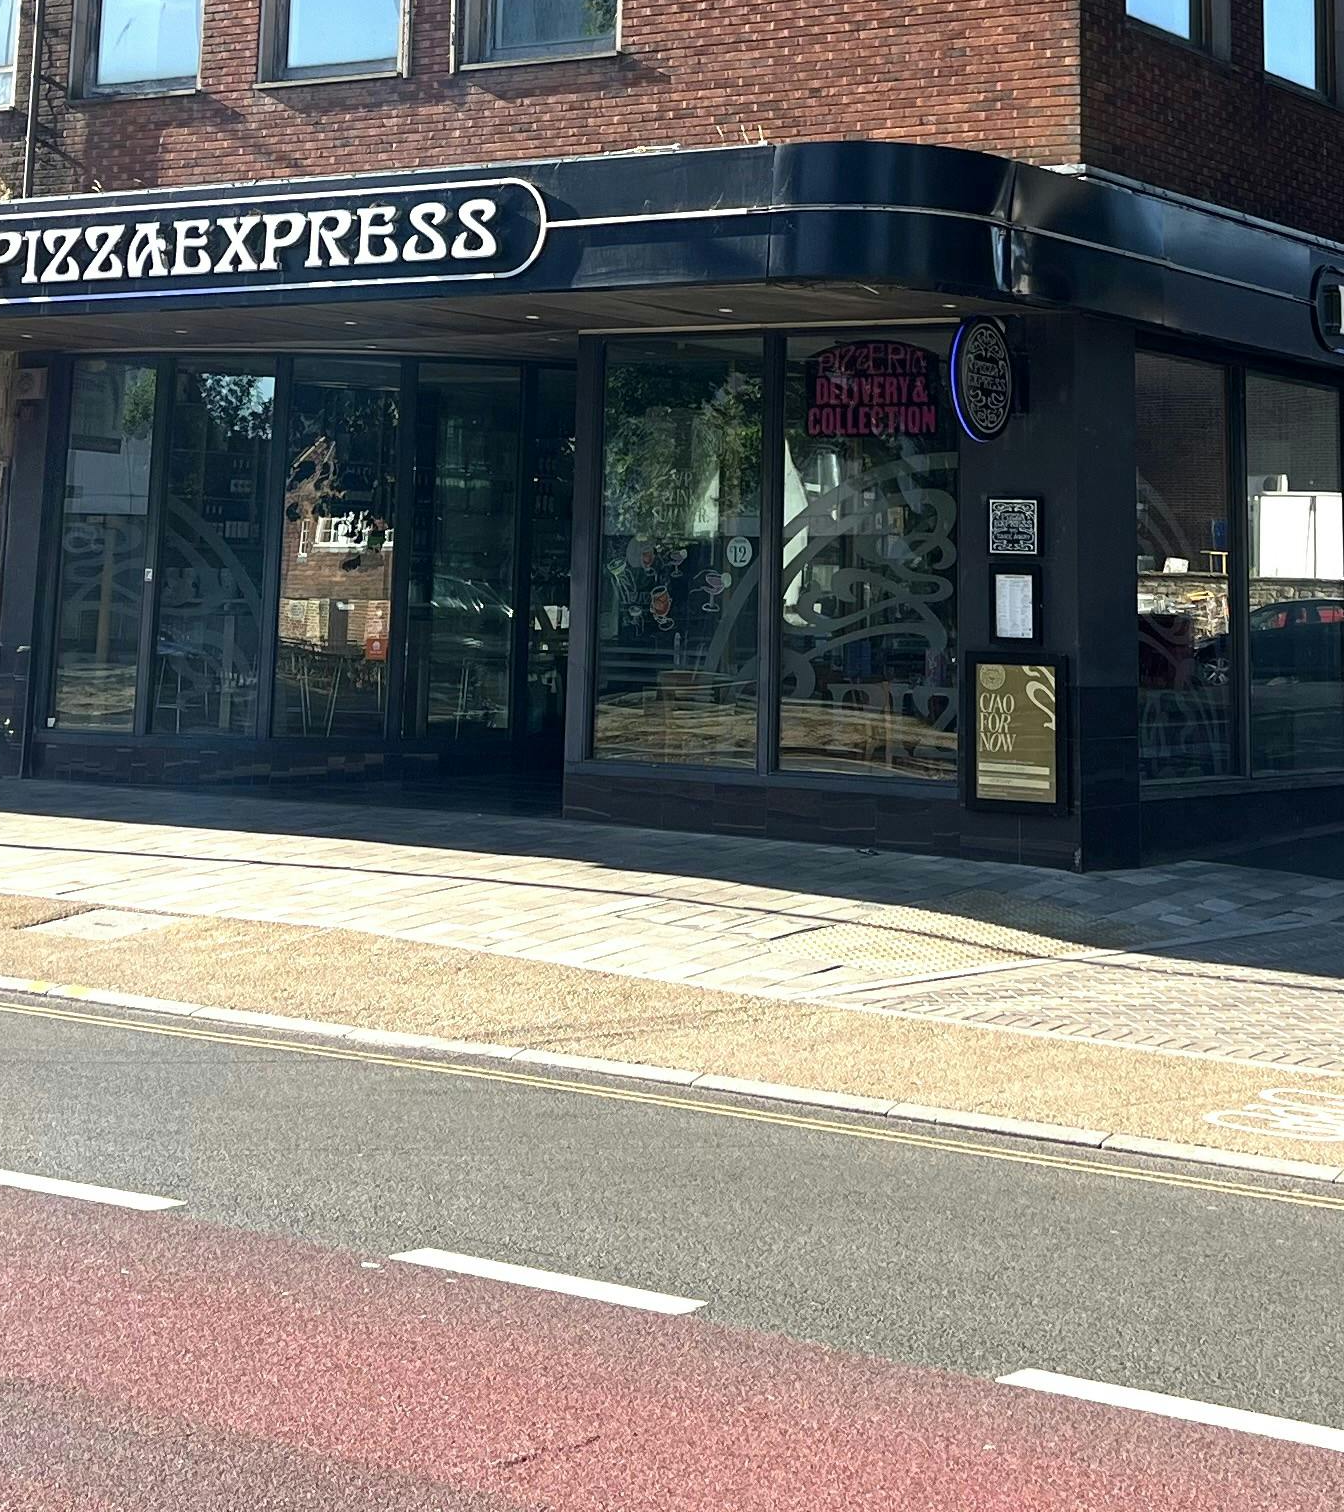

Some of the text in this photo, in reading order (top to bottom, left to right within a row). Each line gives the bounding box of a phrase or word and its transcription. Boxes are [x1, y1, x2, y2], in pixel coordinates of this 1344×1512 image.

[816, 376, 929, 405] DELIVERY &
[808, 406, 937, 435] COLLECTION
[979, 692, 1015, 714] CIAO
[979, 712, 1012, 734] FOR
[979, 732, 1017, 753] NOW
